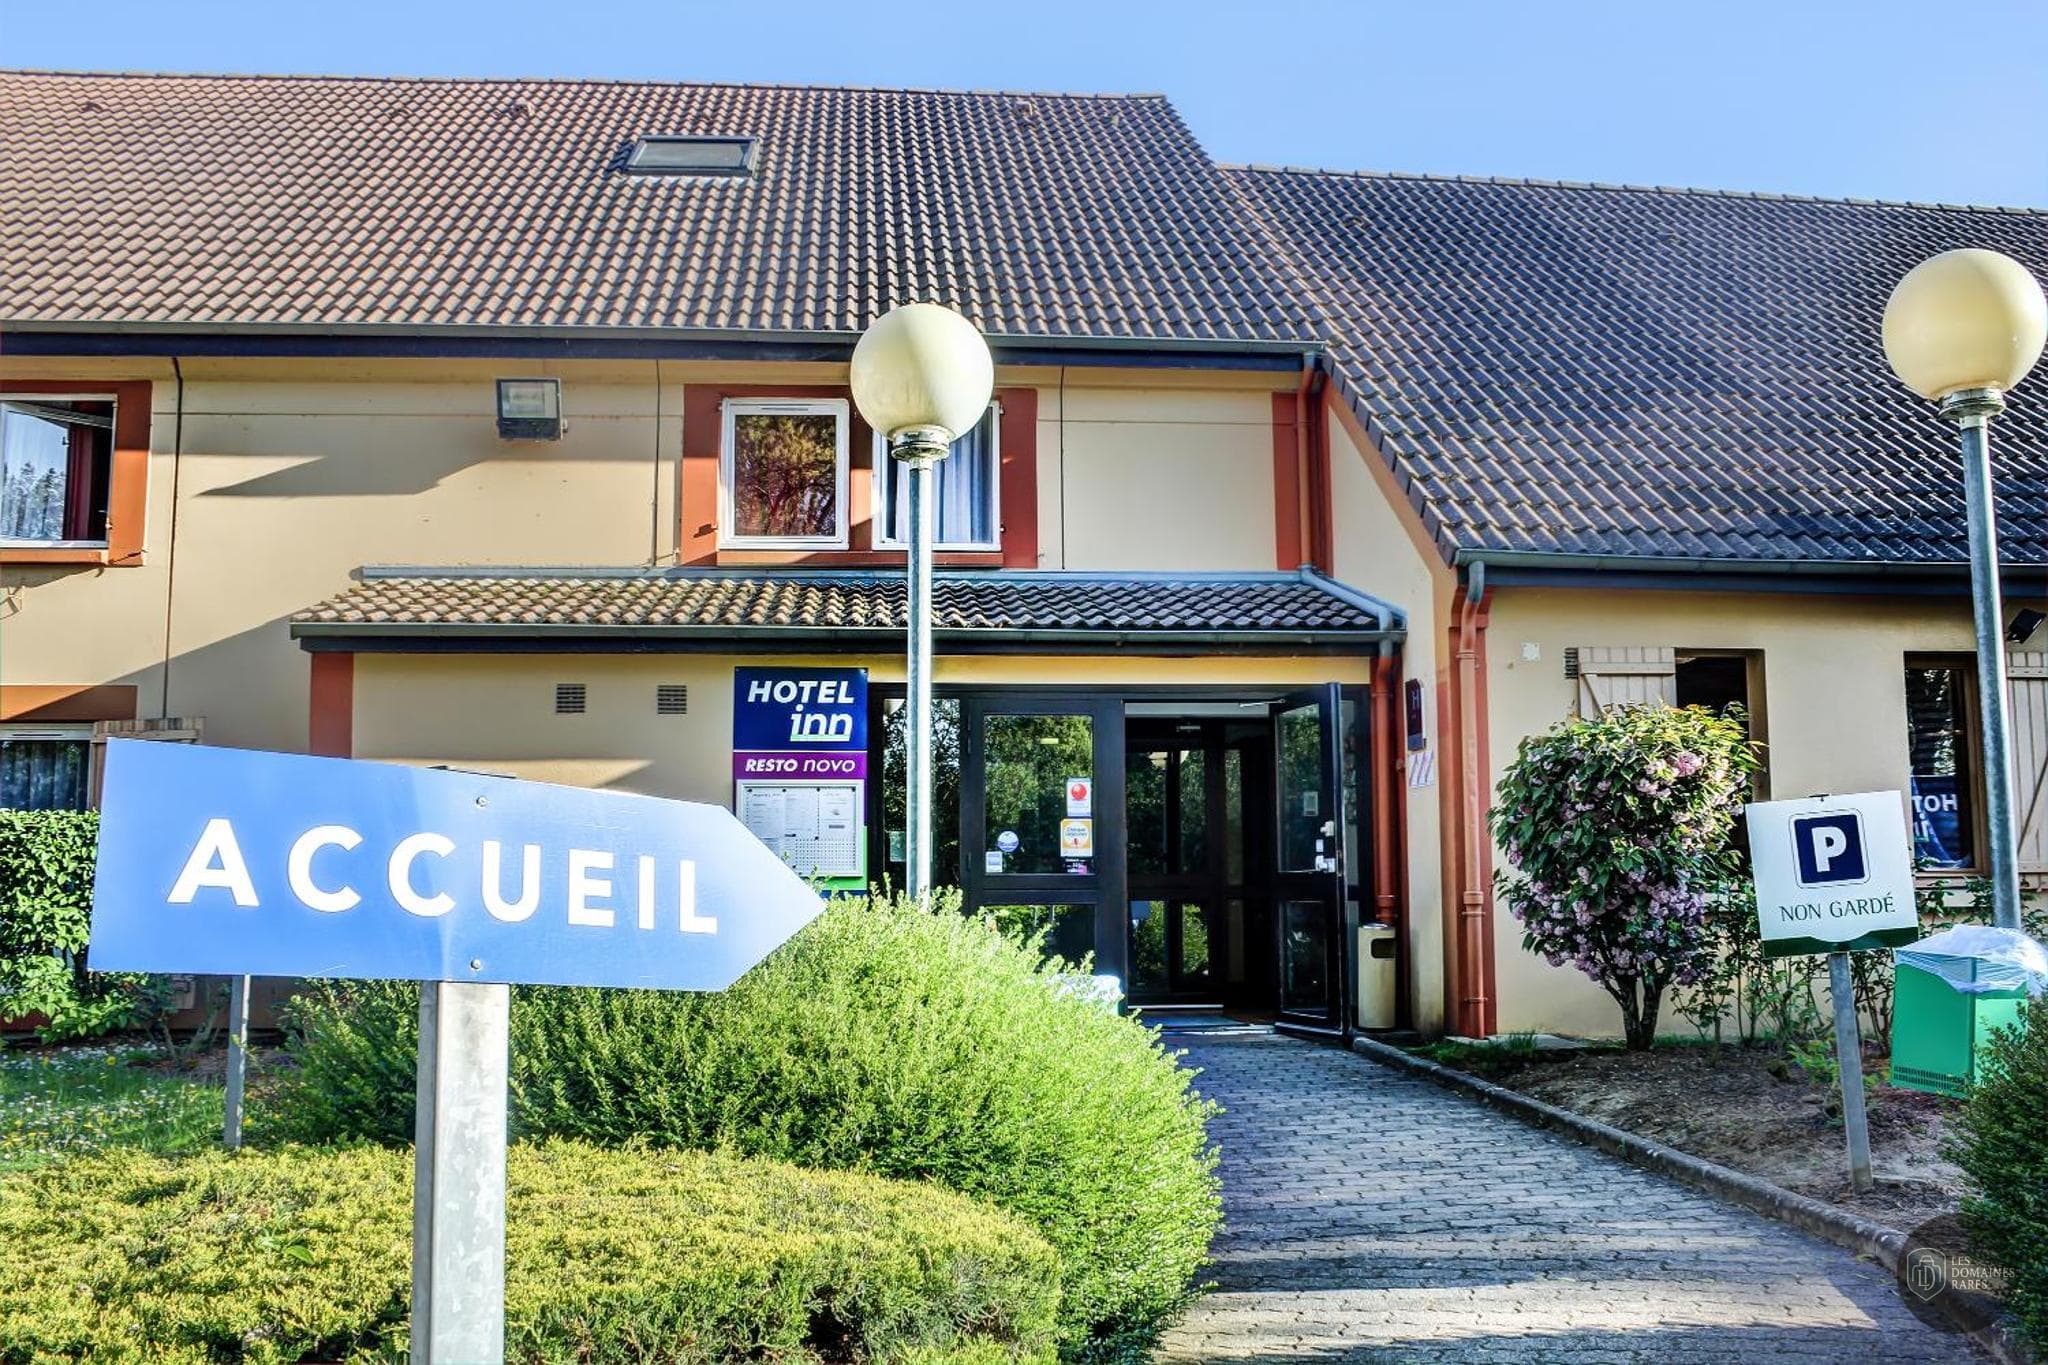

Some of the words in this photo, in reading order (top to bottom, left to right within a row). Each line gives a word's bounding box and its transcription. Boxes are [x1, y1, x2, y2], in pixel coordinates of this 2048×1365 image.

[747, 680, 855, 704] HOTEL
[790, 704, 853, 742] inn
[745, 758, 798, 772] RESTO
[1811, 826, 1847, 873] P
[166, 818, 719, 935] ACCUEIL
[1779, 903, 1821, 921] NON
[1829, 891, 1896, 918] GARDÉ
